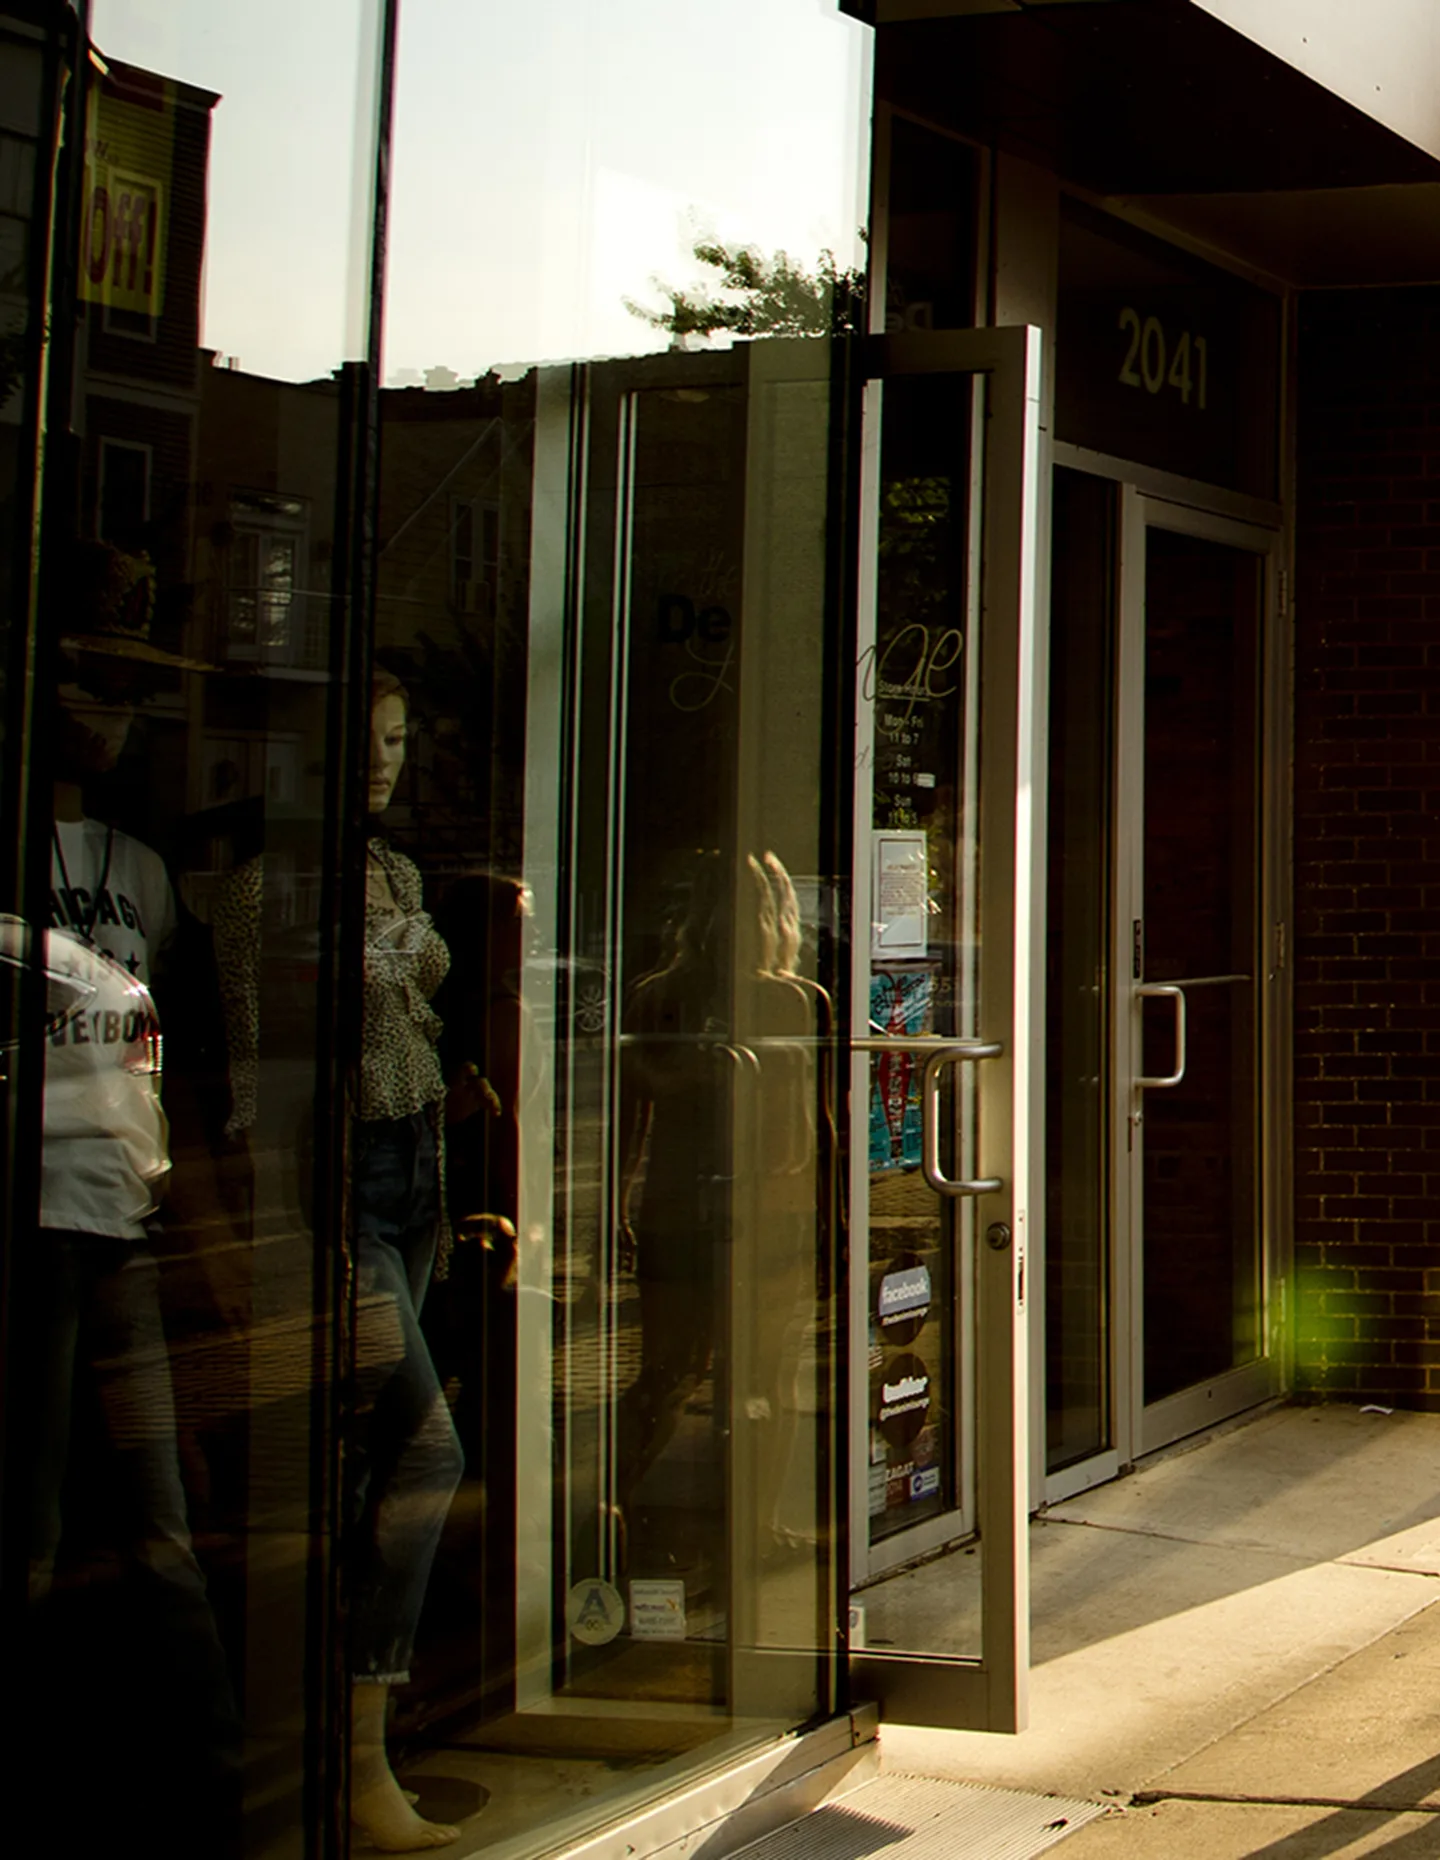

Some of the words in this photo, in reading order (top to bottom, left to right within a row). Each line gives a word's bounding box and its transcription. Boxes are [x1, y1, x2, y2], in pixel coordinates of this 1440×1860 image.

[1117, 305, 1207, 410] 2041
[882, 1277, 928, 1305] facebook
[882, 1374, 928, 1404] twitter
